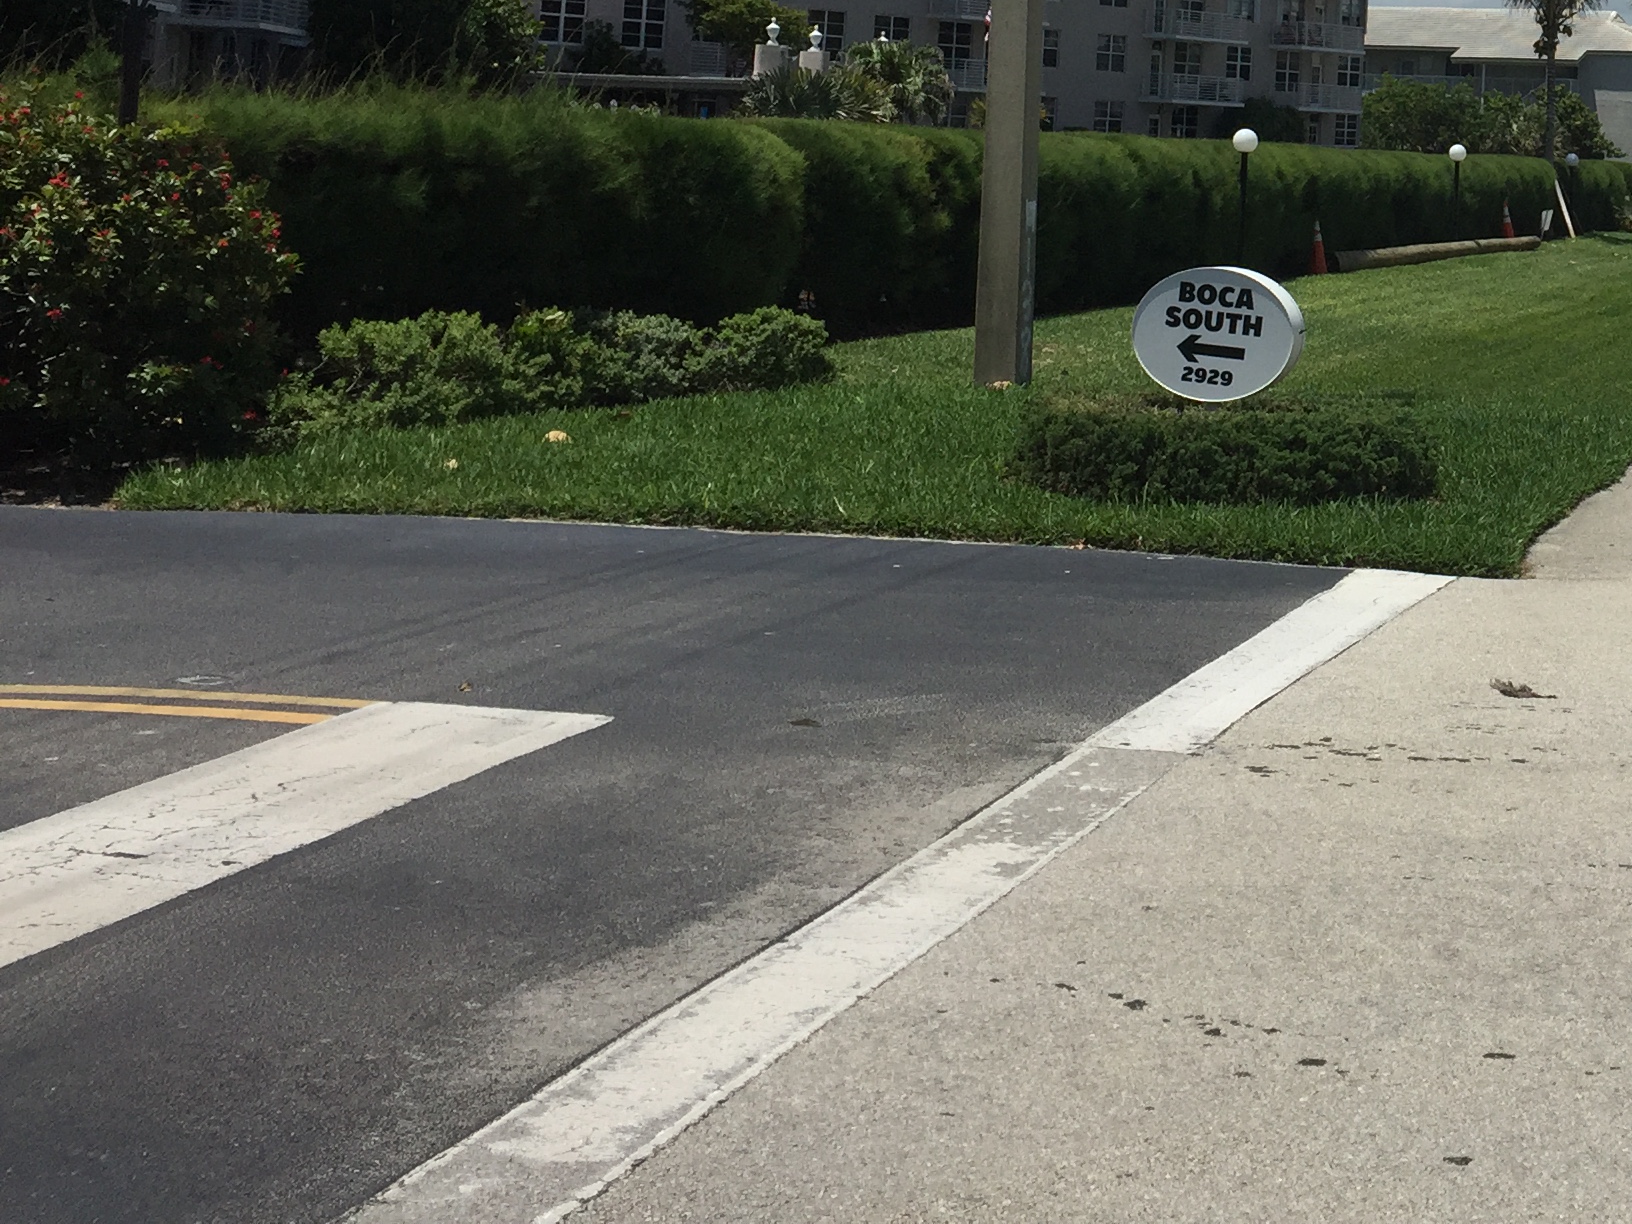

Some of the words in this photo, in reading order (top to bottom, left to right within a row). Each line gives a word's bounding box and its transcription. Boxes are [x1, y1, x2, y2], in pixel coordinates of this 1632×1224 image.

[1178, 281, 1254, 310] BOCA
[1165, 306, 1263, 337] SOUTH
[1181, 366, 1233, 386] 2929
